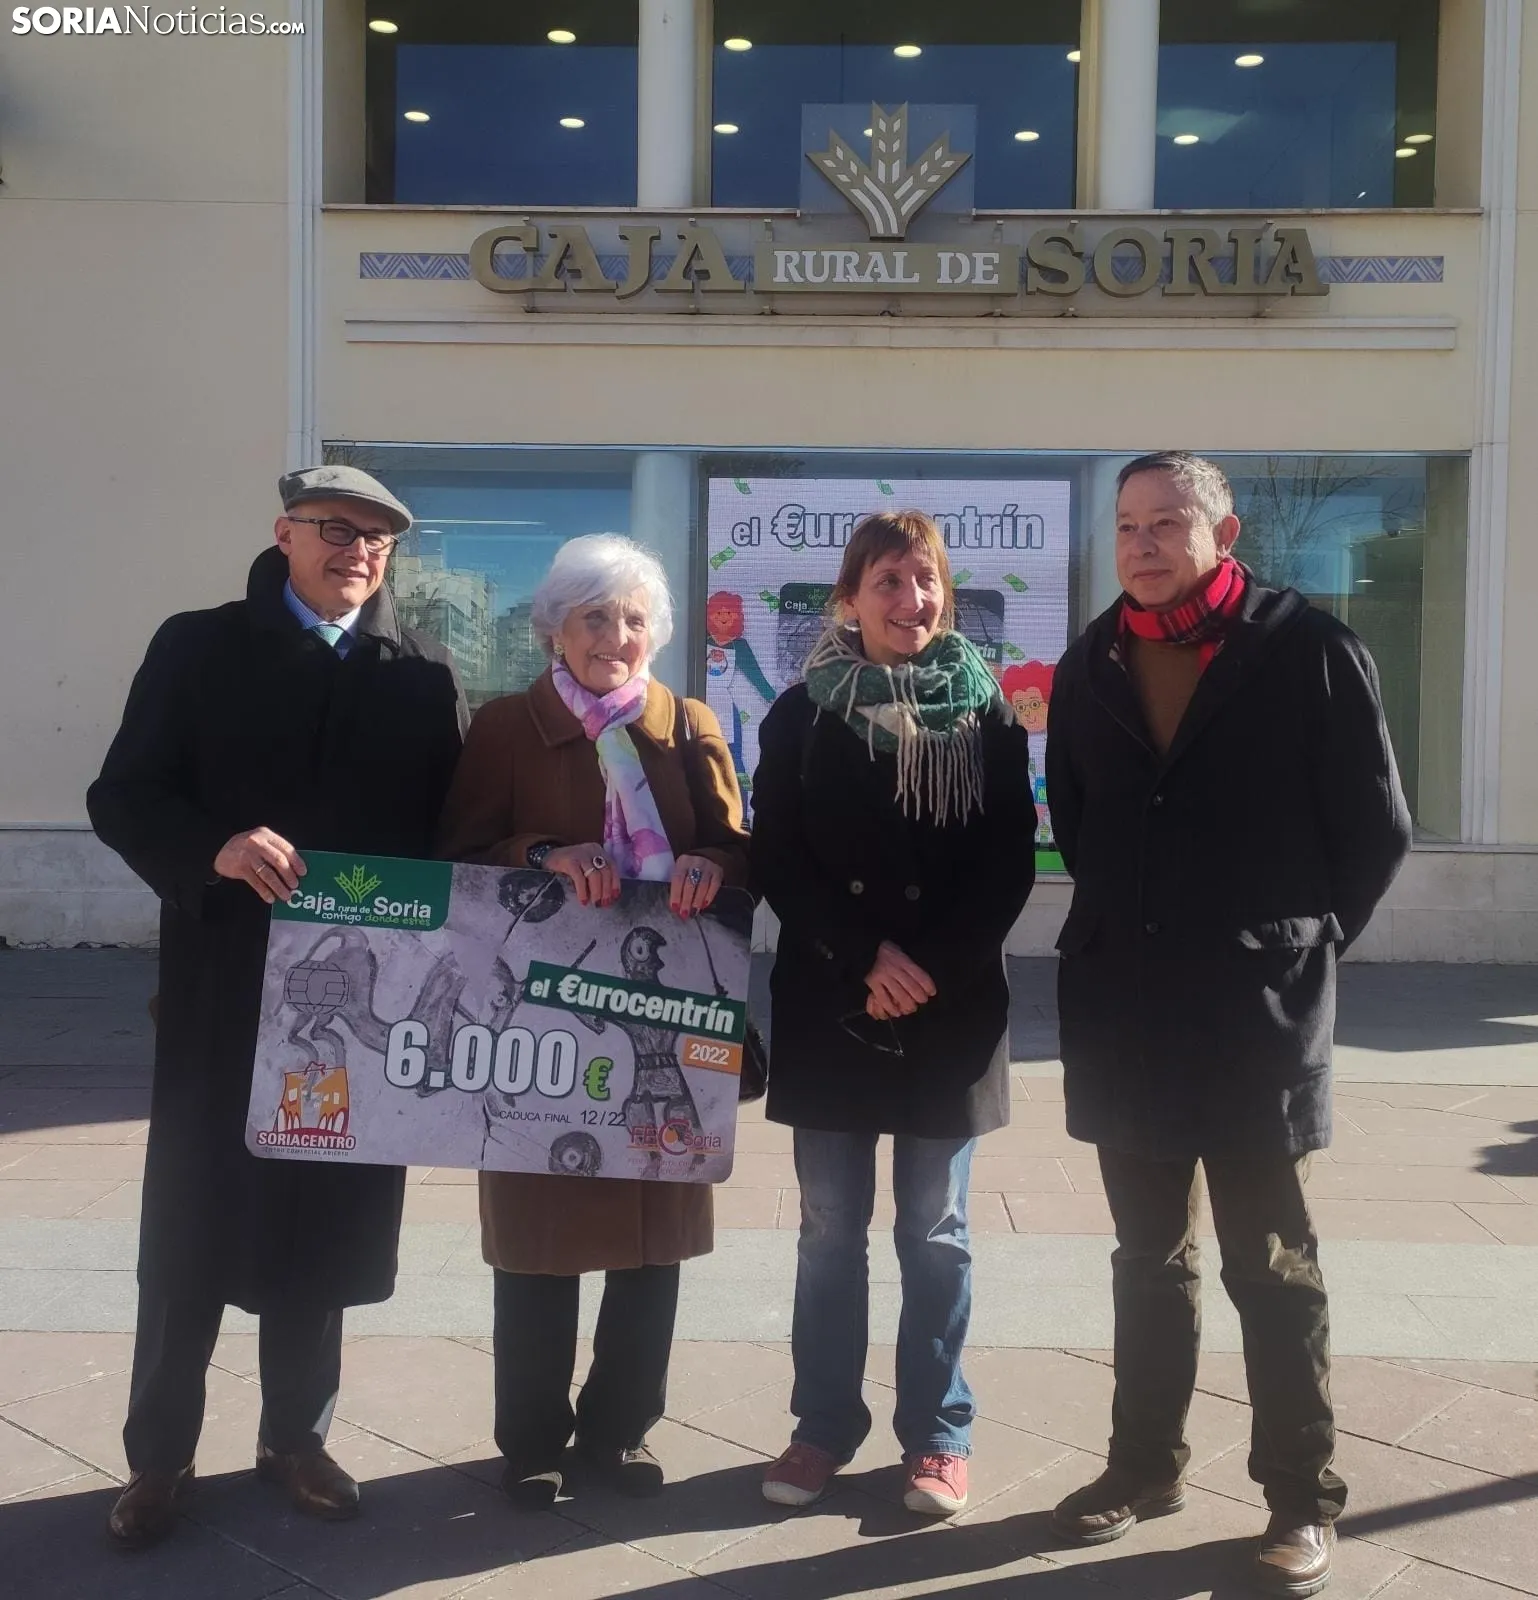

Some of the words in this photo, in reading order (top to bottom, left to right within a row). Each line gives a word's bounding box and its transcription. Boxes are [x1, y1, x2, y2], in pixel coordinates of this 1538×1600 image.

[469, 224, 747, 299] CAJA
[773, 249, 920, 284] RURAL
[937, 251, 1000, 284] DE
[1026, 226, 1330, 297] SORIA
[731, 516, 761, 547] el
[771, 503, 1045, 550] €urntrín
[784, 600, 808, 612] Caja
[287, 889, 336, 915] Caja
[338, 905, 358, 914] rural
[359, 906, 371, 915] de
[373, 896, 431, 919] Soria
[321, 910, 362, 925] contigo
[365, 914, 399, 924] donde
[530, 978, 551, 999] el
[556, 974, 735, 1035] €urocentrín
[384, 1019, 579, 1099] 6.000
[583, 1056, 614, 1100] €
[689, 1043, 730, 1066] 2022
[499, 1110, 541, 1123] CADUCA
[544, 1112, 573, 1124] FINAL
[580, 1110, 627, 1127] 12/22
[257, 1131, 357, 1150] SORIACENTRO
